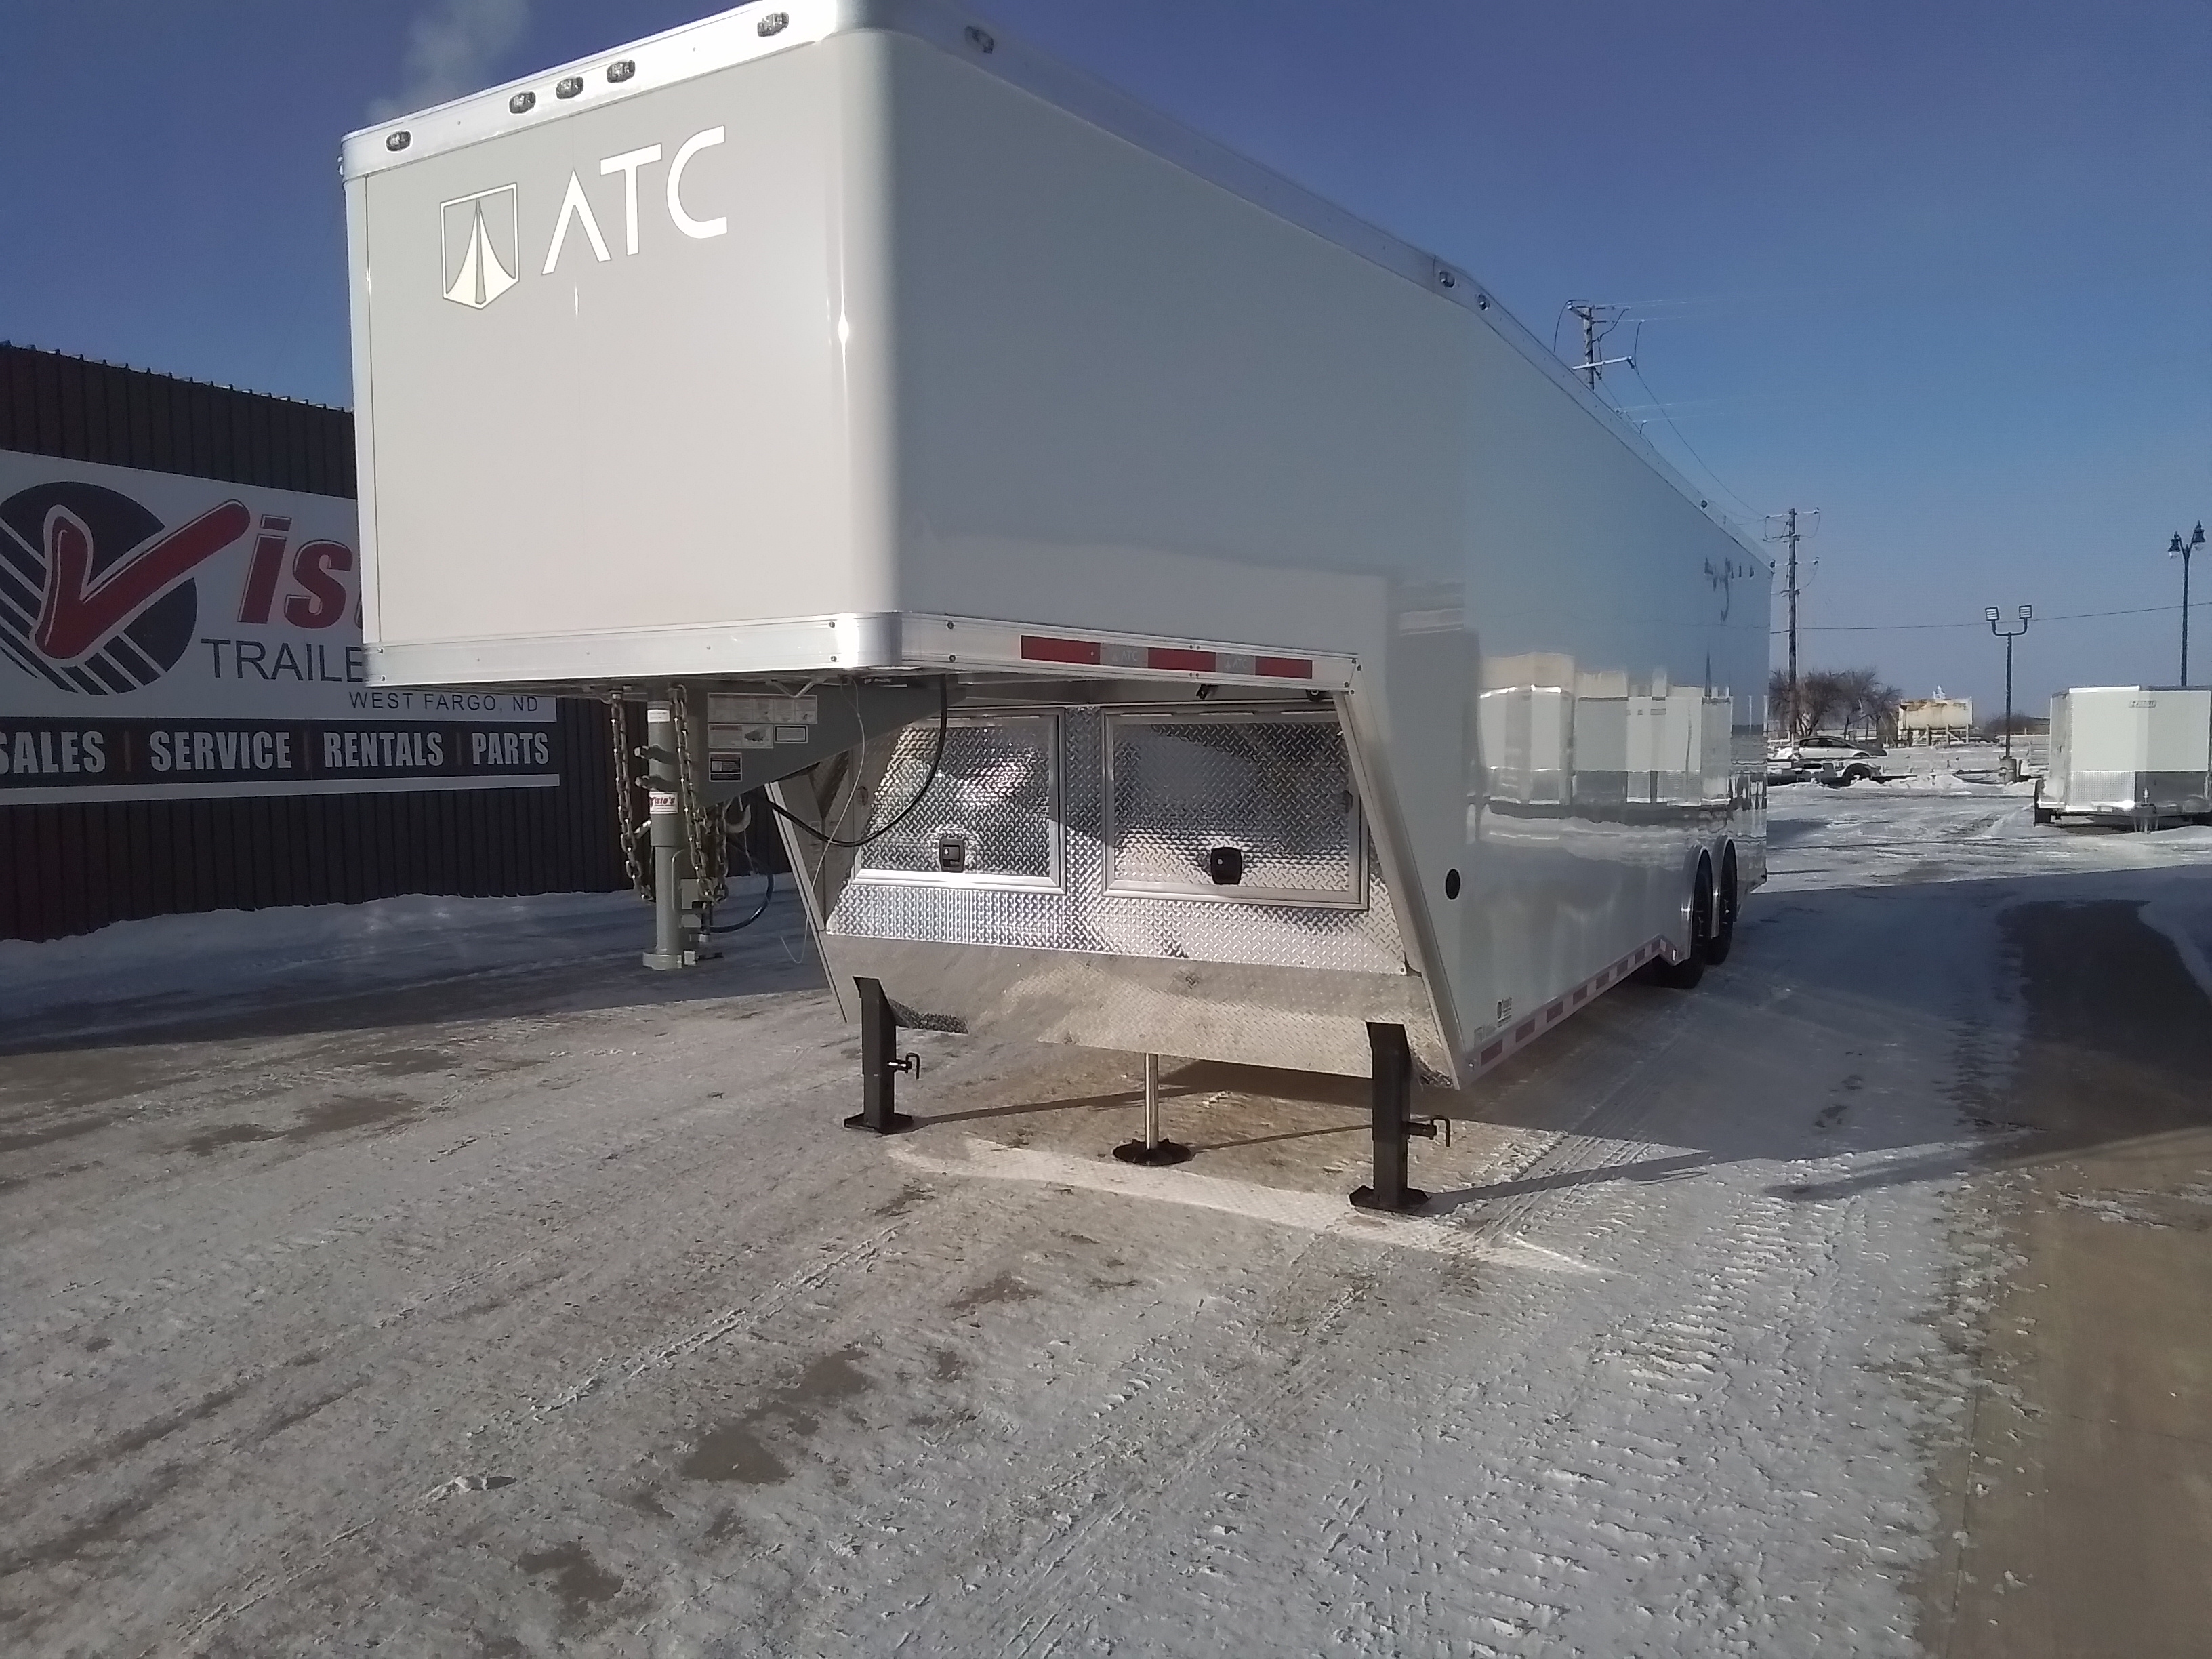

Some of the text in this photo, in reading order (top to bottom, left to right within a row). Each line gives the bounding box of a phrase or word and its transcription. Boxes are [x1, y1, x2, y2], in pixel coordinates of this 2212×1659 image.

[541, 125, 728, 276] ATC
[29, 499, 363, 660] Vis
[349, 691, 538, 714] WEST FARGO, ND
[149, 731, 293, 772] SERVICE
[323, 731, 445, 769] RENTALS
[472, 731, 550, 766] PARTS
